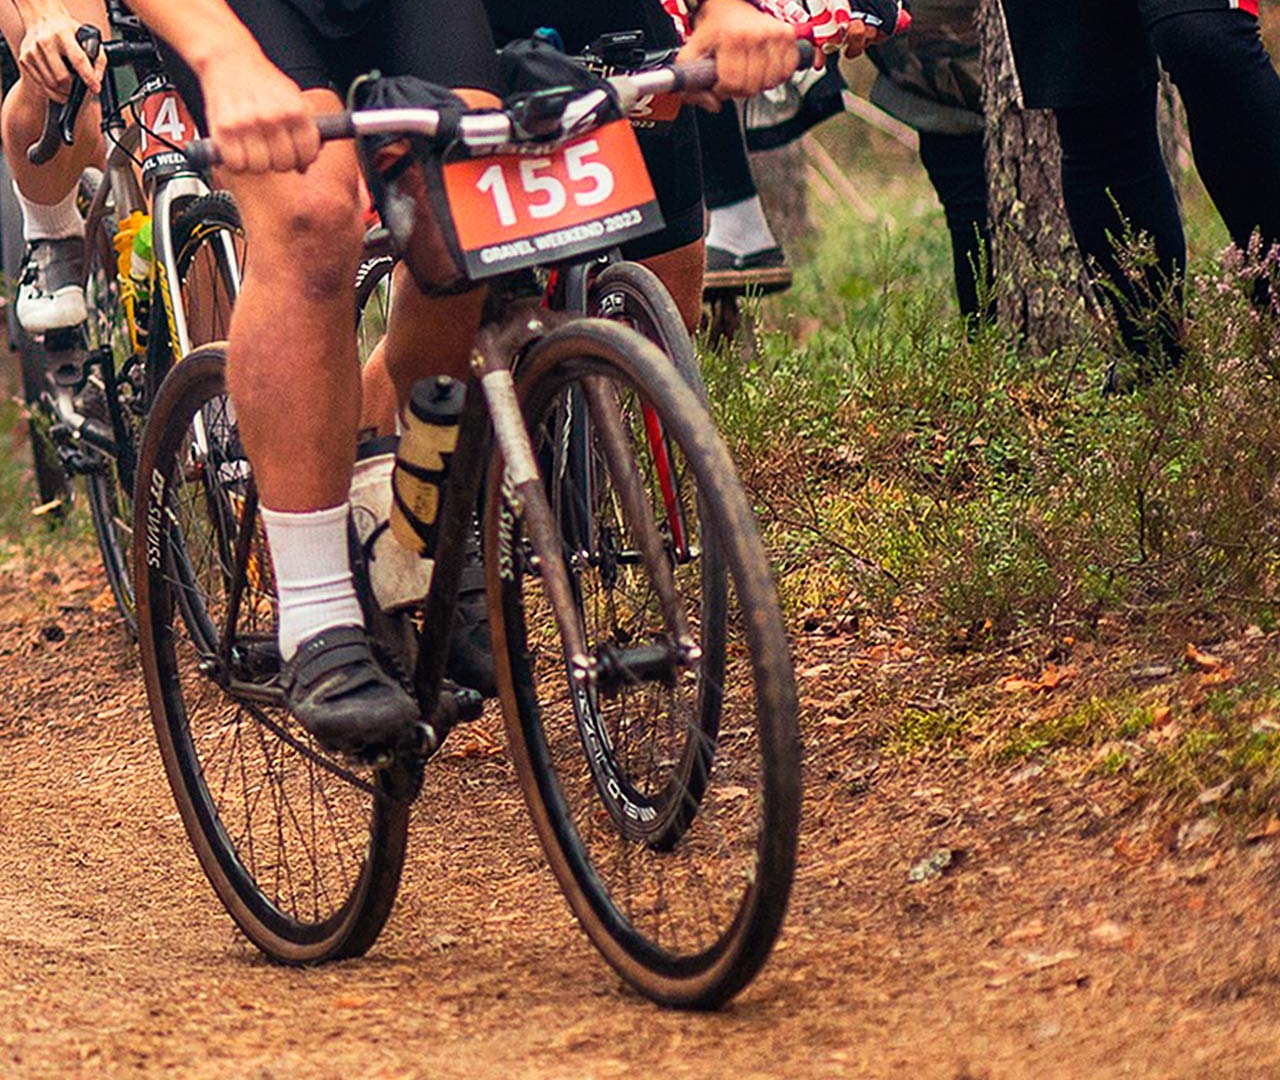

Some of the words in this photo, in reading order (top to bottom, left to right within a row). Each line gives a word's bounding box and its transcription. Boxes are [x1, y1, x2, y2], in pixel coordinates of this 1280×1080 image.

[477, 140, 615, 227] 155
[479, 239, 536, 264] GRAVEL
[536, 221, 604, 250] WEEKEND
[604, 209, 643, 233] 2023
[145, 506, 163, 569] SWISS
[498, 503, 516, 582] SWISS
